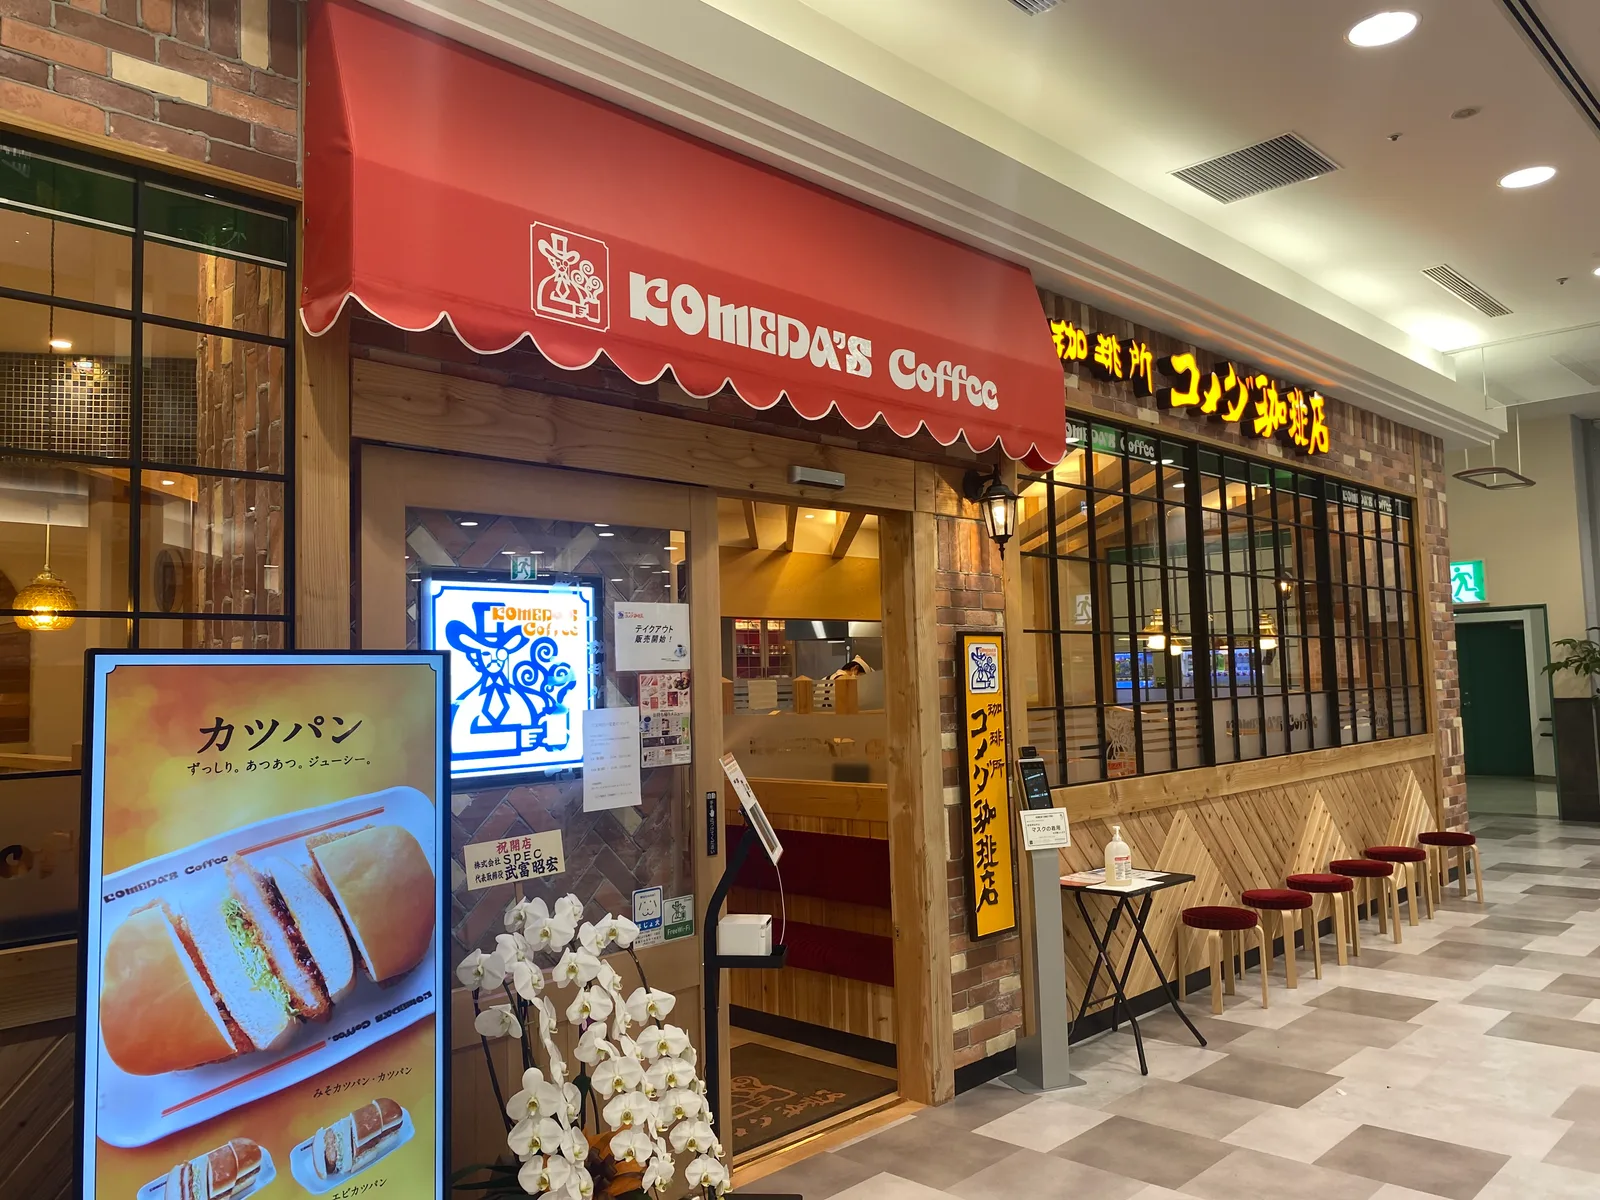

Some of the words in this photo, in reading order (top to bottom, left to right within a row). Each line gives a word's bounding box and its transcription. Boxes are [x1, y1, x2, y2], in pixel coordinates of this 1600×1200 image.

[629, 271, 872, 378] KOMEDA'S
[888, 349, 999, 411] Coffee
[1050, 320, 1153, 395] 珈琲所
[1170, 352, 1330, 455] コメダ珈琲店
[635, 624, 674, 633] テイクアウト
[196, 715, 363, 754] カツパン
[987, 703, 1005, 779] 珈琲所
[970, 708, 999, 914] コメダ珈琲店
[474, 857, 502, 870] 株式会社
[503, 849, 542, 865] SPEC
[496, 836, 532, 854] 祝開店
[103, 871, 179, 904] KOMEDA'S
[184, 855, 229, 875] Coffee
[475, 869, 504, 884] 代表取締役
[332, 1179, 388, 1200] エビカツパン
